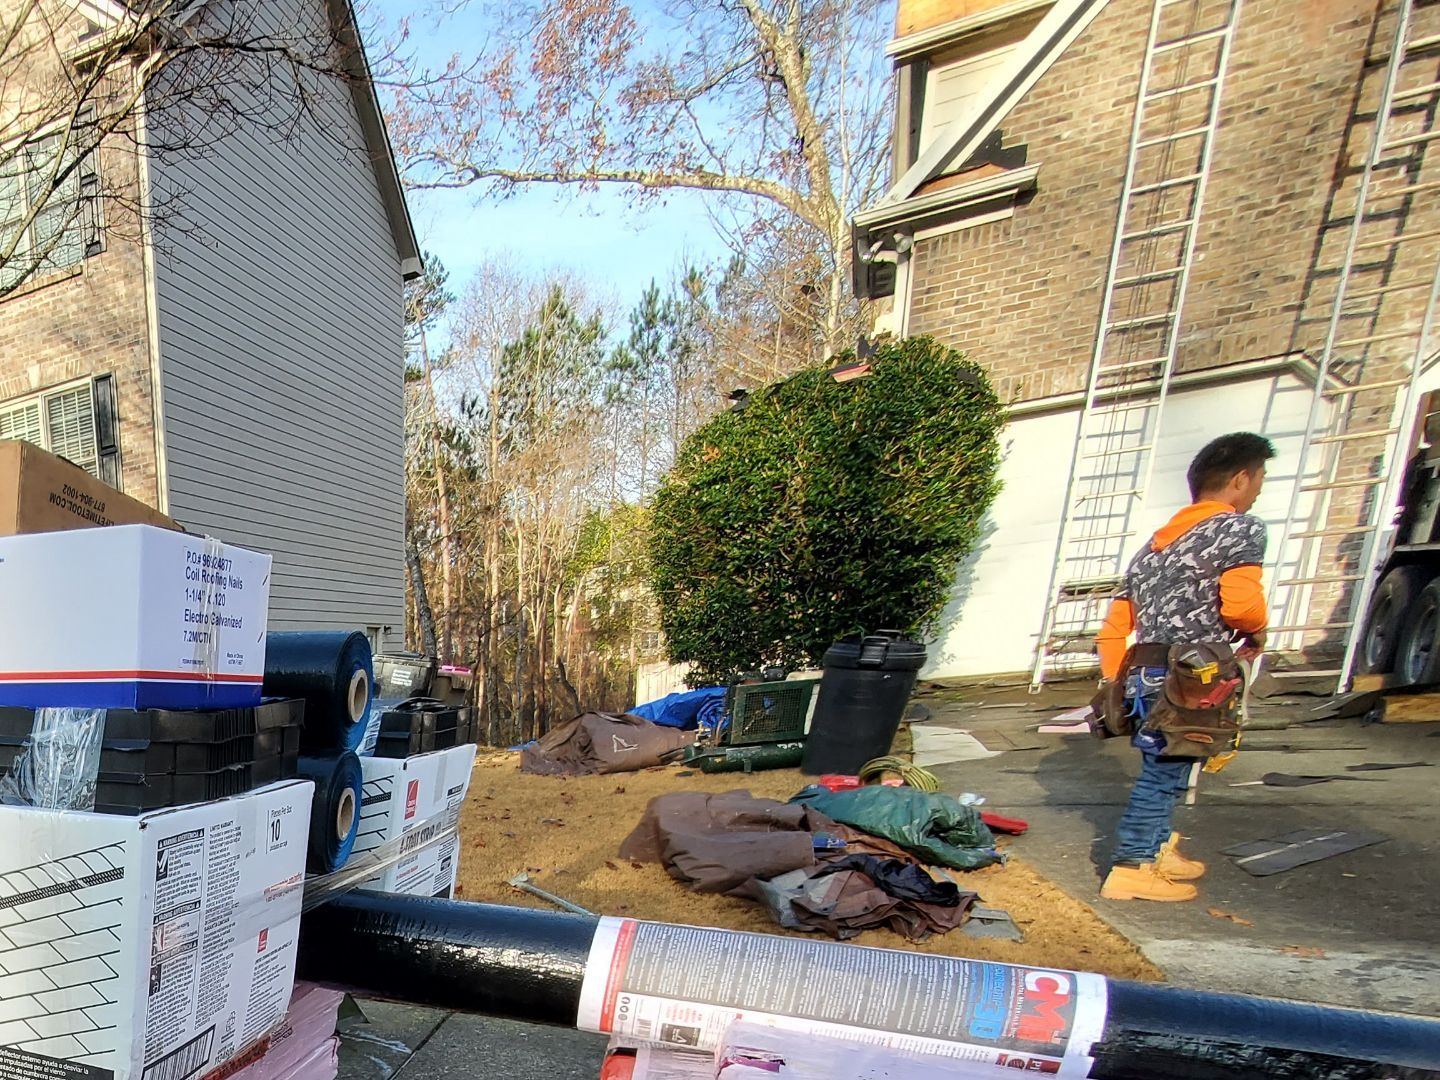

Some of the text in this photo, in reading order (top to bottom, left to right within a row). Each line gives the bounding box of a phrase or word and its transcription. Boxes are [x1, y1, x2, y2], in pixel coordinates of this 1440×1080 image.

[185, 566, 243, 590] Coil Roofing Nails
[184, 608, 243, 629] Electro Galvanized
[270, 819, 281, 843] 10
